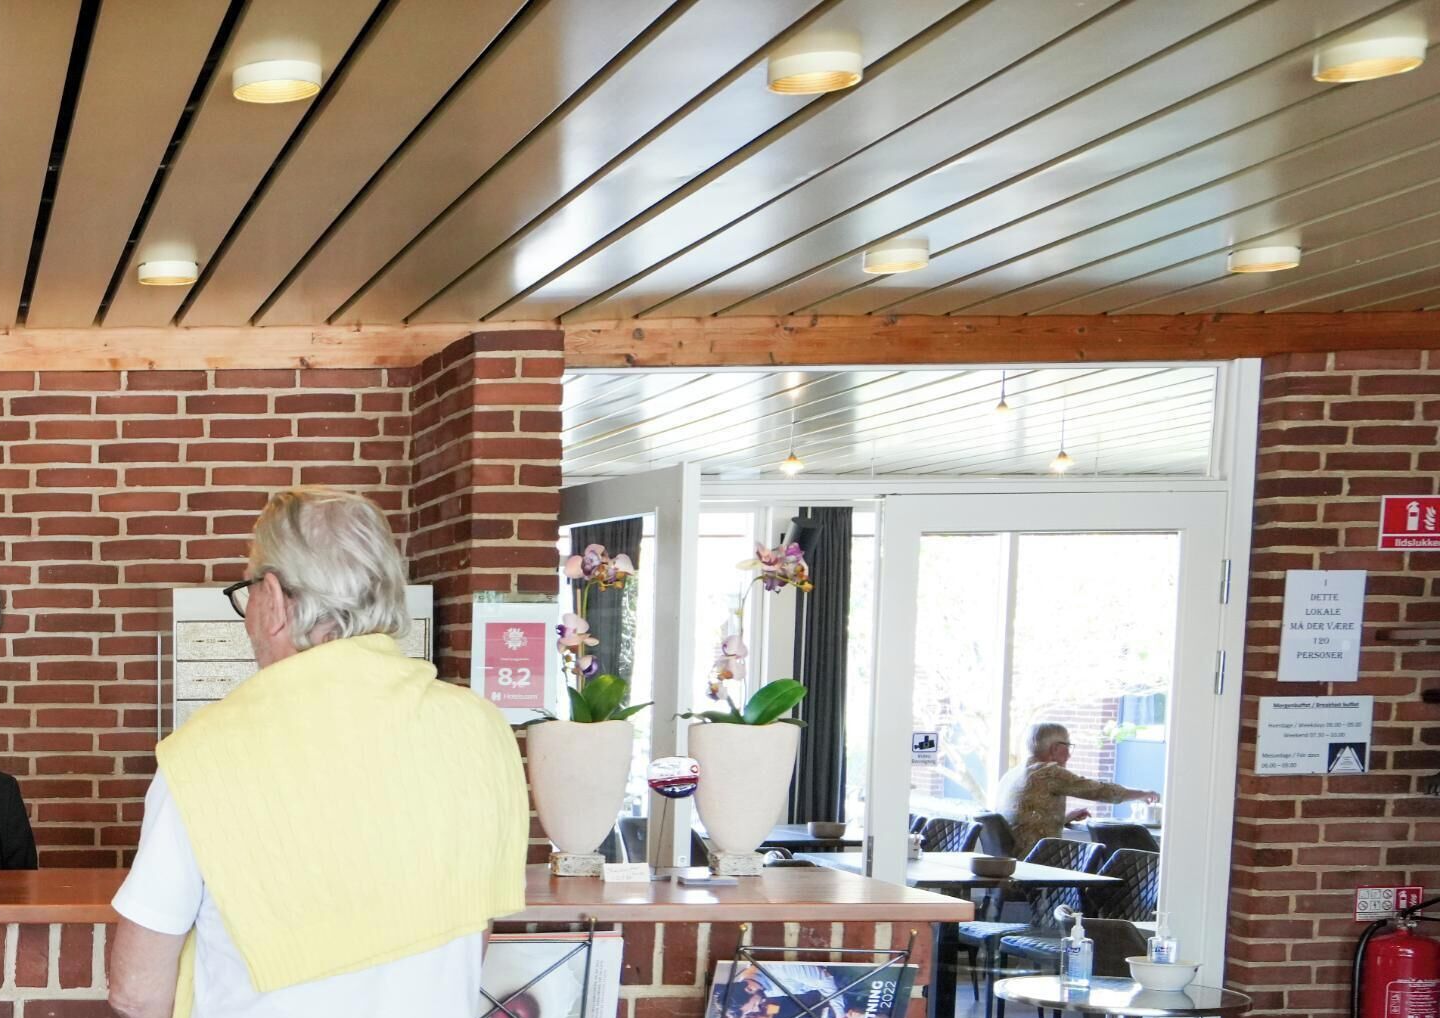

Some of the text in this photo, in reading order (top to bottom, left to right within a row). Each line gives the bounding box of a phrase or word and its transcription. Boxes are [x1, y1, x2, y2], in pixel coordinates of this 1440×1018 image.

[1310, 593, 1340, 601] DETTE
[1305, 608, 1343, 616] LOKALE
[1289, 620, 1355, 631] MÅ DER VÆRE
[1296, 651, 1344, 660] PERSONER
[497, 667, 532, 689] 8,2
[879, 980, 897, 1009] 2022
